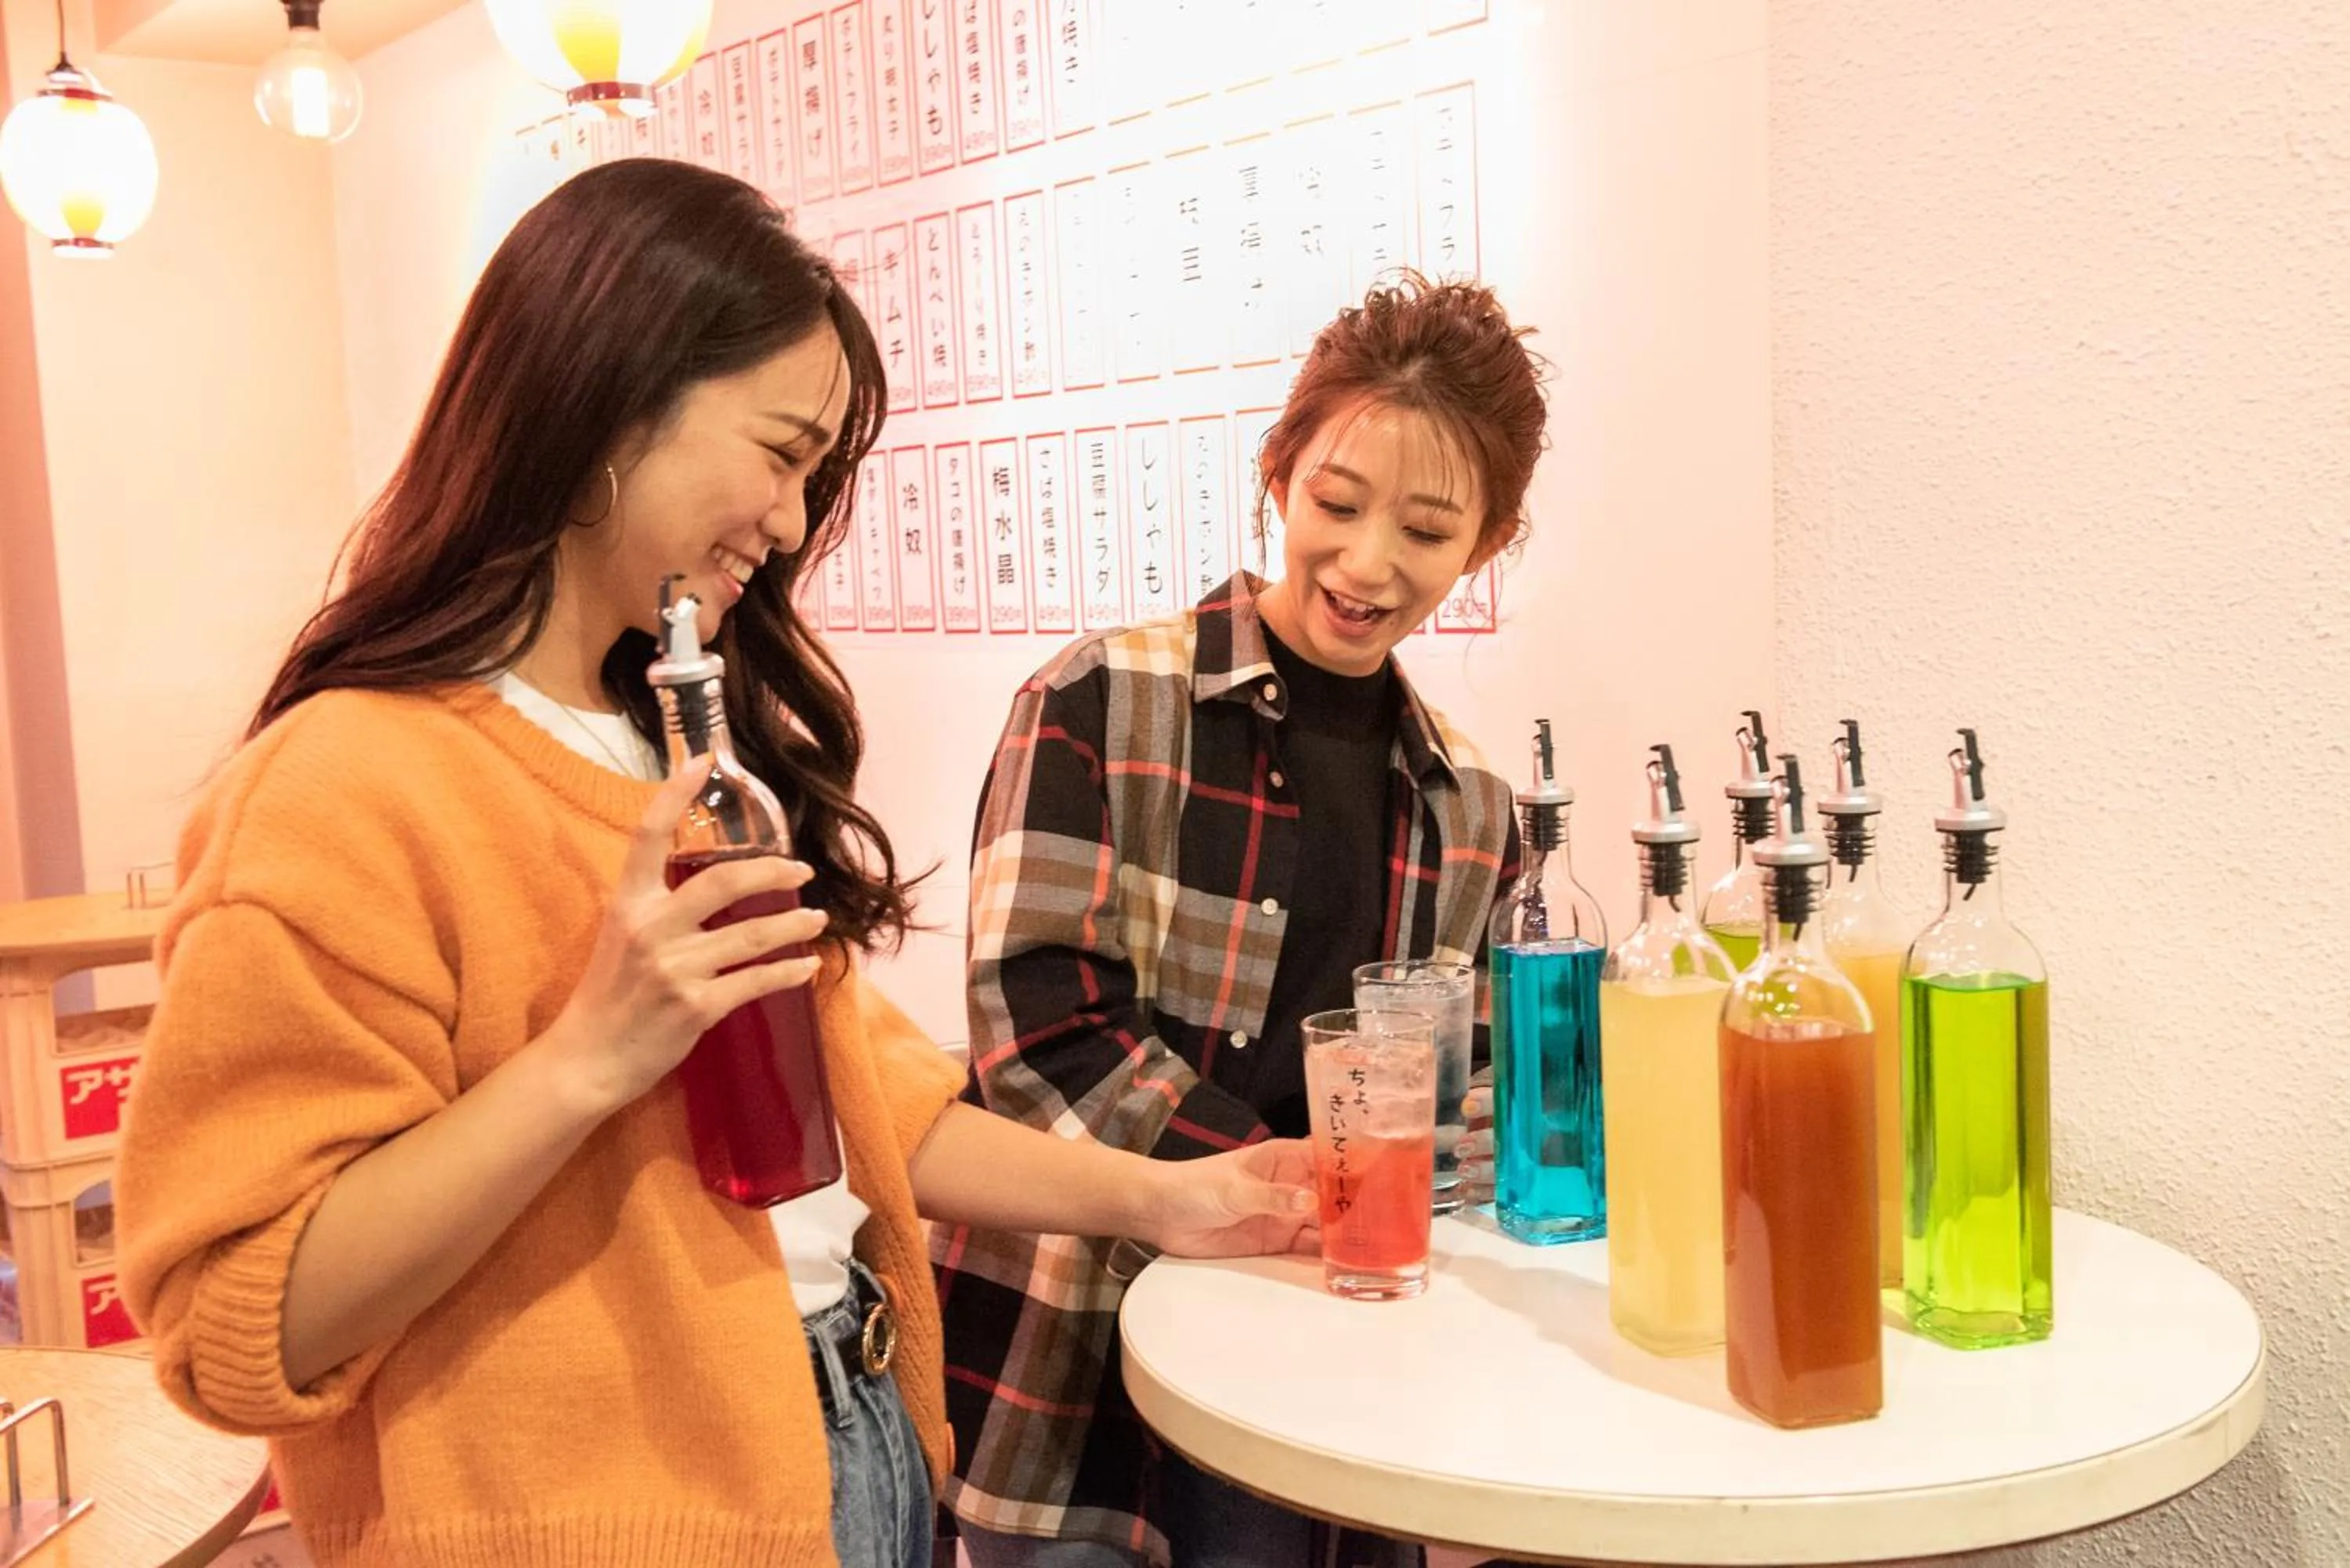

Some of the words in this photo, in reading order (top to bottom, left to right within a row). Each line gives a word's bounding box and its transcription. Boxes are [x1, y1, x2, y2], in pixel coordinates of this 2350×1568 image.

[883, 248, 905, 370] キムチ
[902, 481, 924, 557] 冷奴
[1090, 442, 1111, 594] 豆腐サラダ
[1141, 436, 1163, 595] ししゃも
[1347, 1068, 1369, 1115] ちょ、
[1327, 1093, 1353, 1216] きいてぇーや
